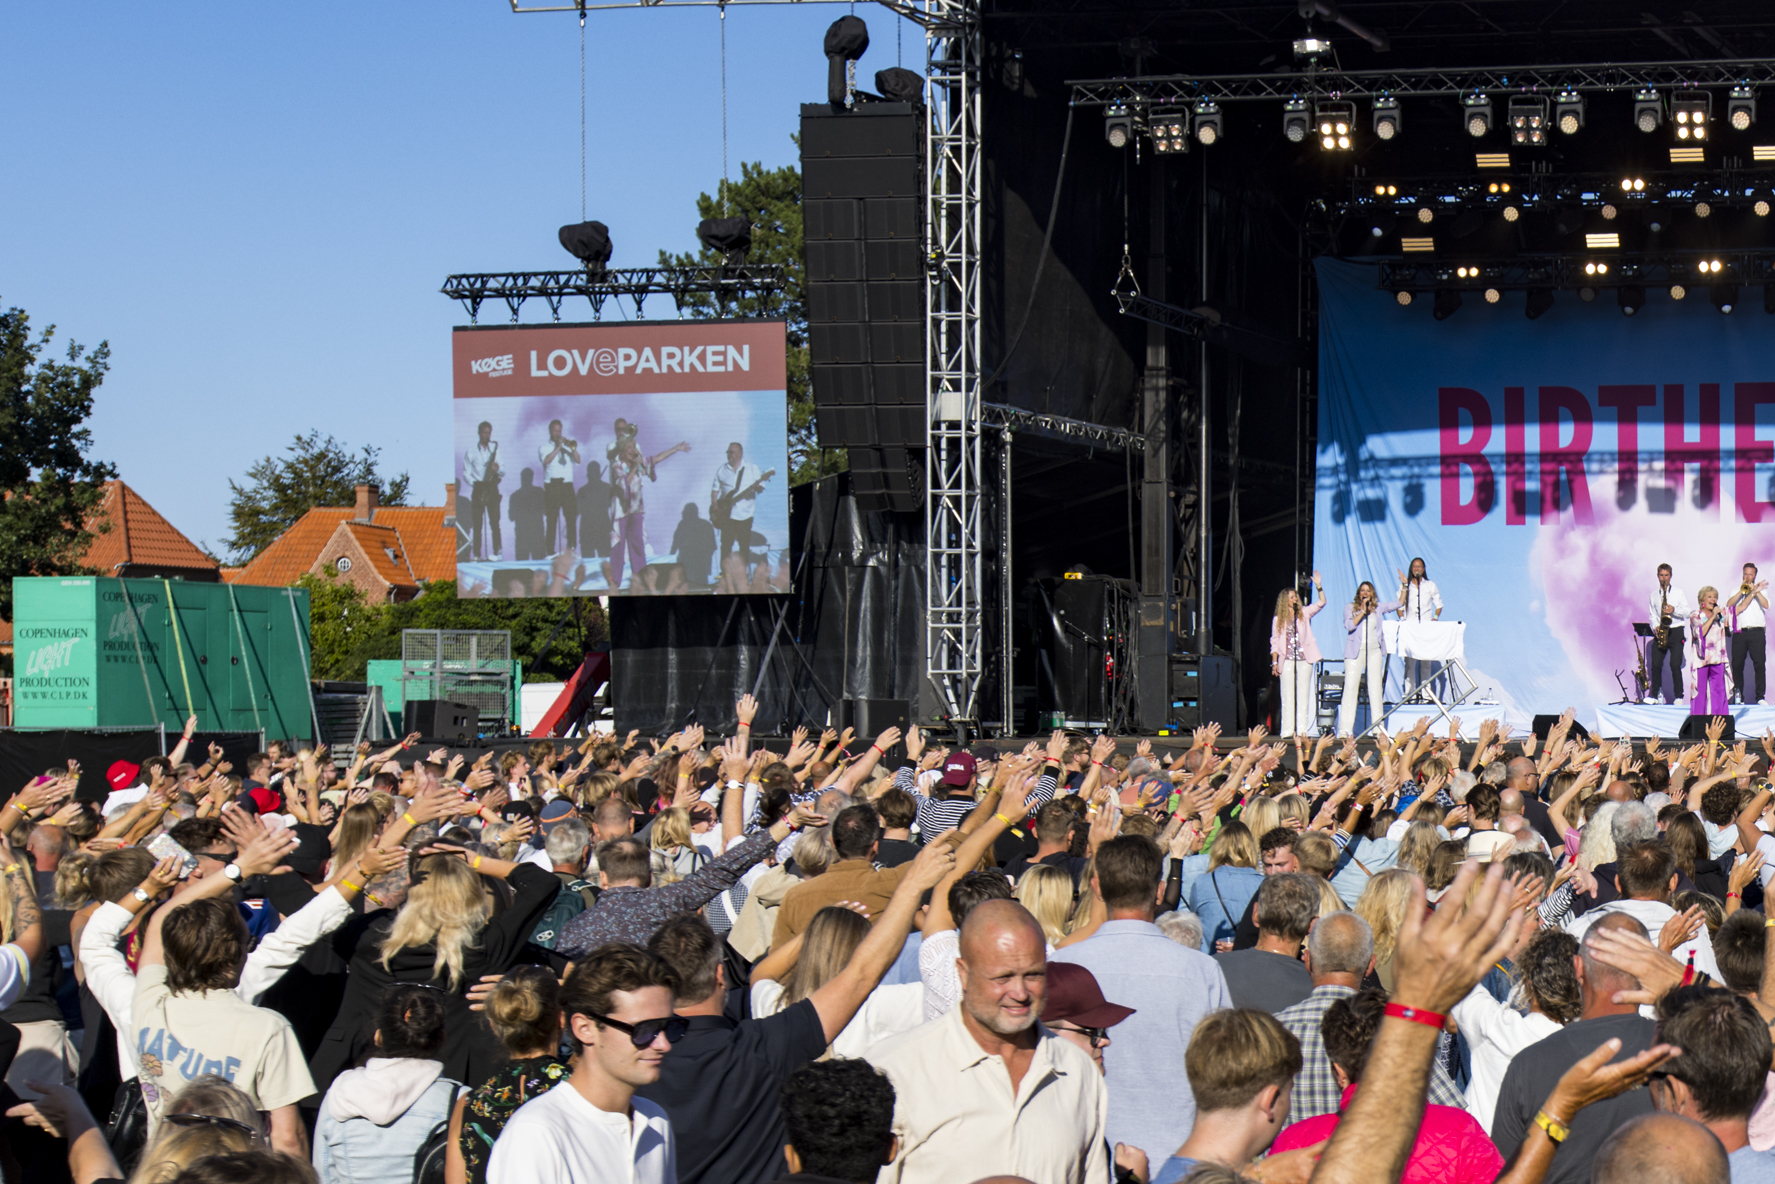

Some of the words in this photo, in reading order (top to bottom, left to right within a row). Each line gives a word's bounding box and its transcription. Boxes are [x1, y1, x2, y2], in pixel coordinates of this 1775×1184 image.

[471, 354, 514, 374] KØGE
[19, 628, 88, 639] COPENHAGEN
[26, 637, 80, 678] LIGHT
[19, 677, 90, 688] PRODUCTION
[22, 691, 88, 700] WWW.CLP.DK
